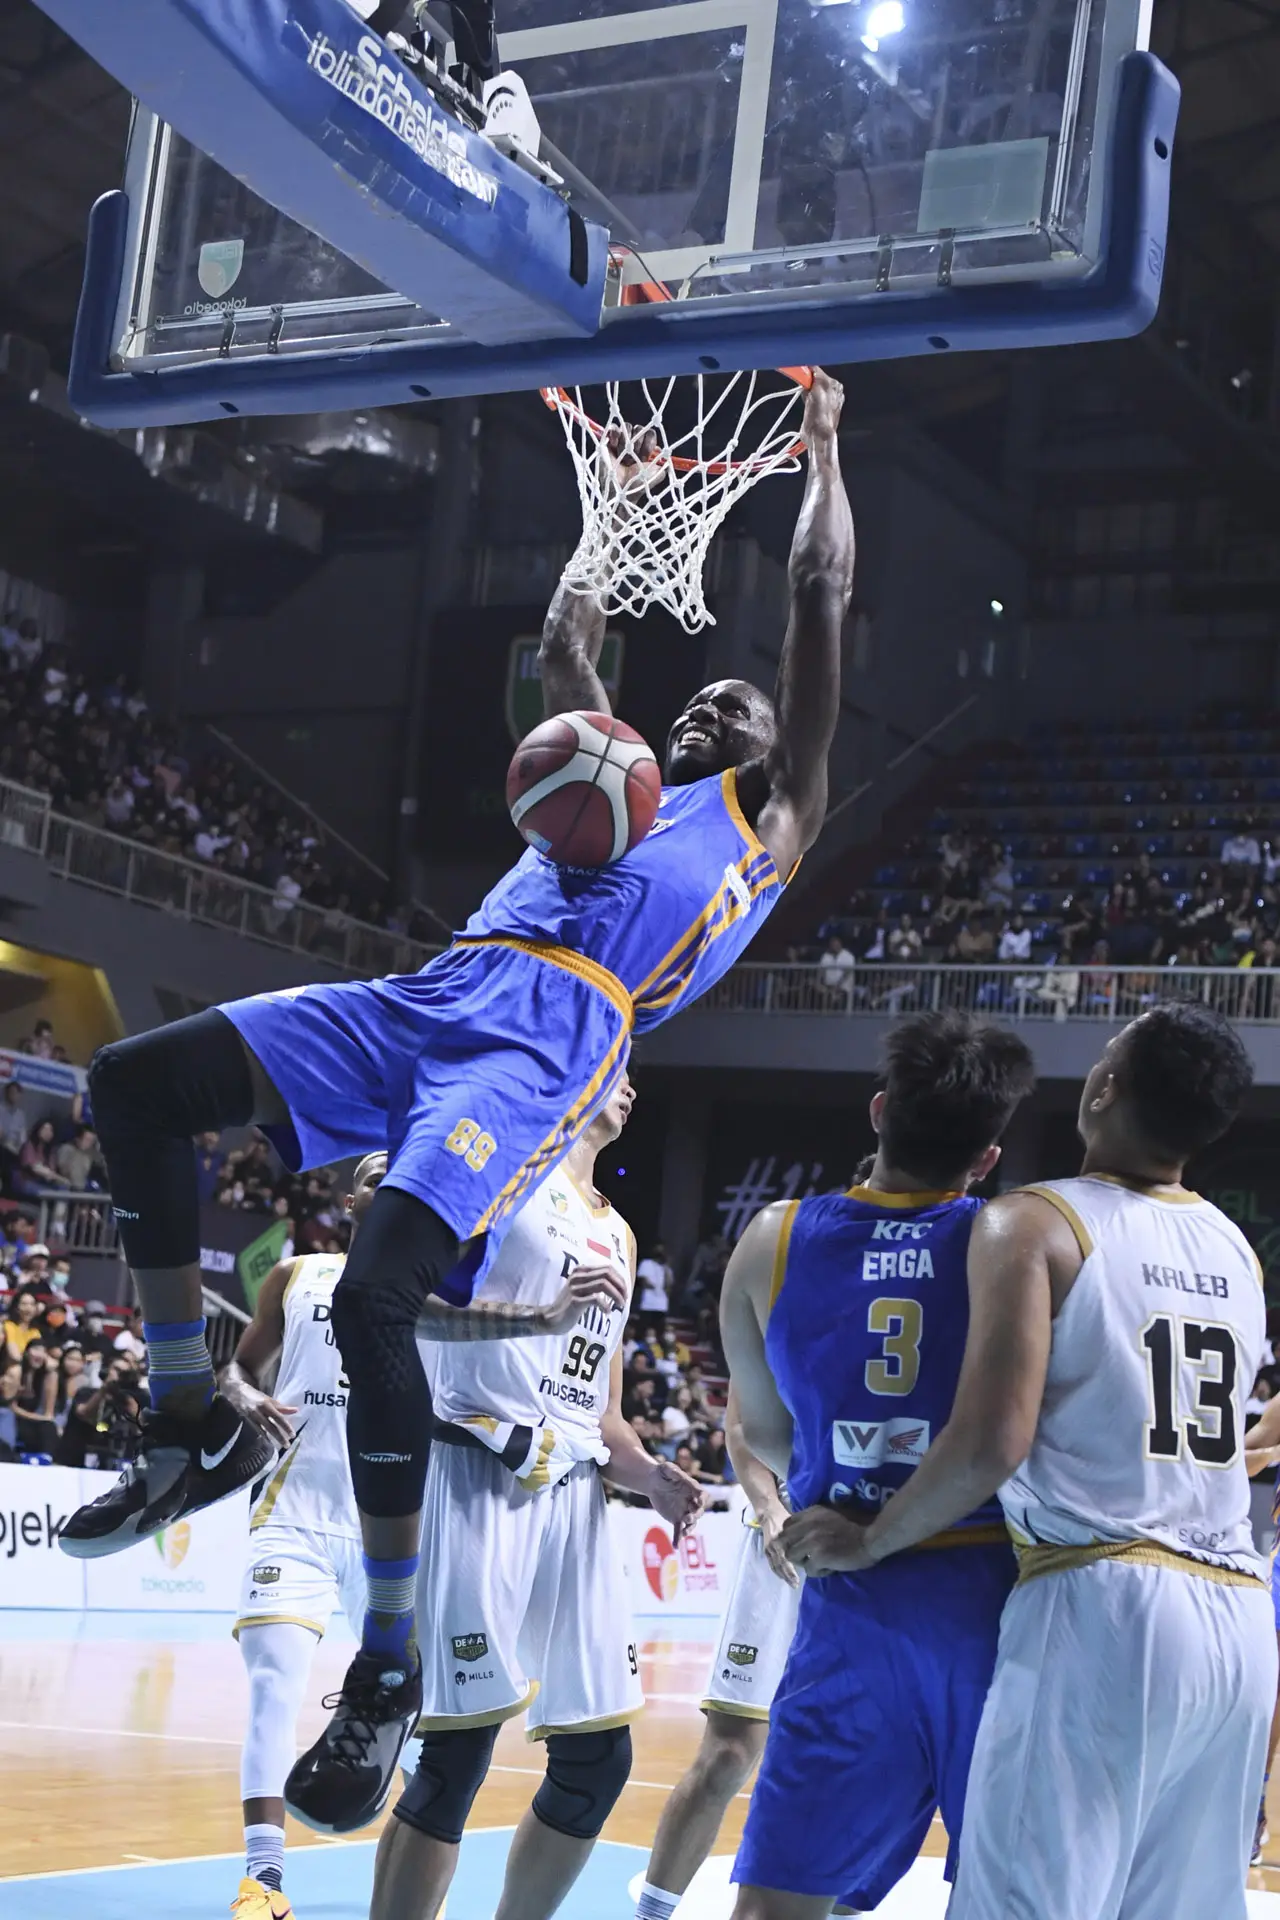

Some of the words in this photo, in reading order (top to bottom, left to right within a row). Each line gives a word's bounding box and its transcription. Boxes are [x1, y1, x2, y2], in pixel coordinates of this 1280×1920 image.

[445, 1117, 497, 1172] 89
[871, 1219, 933, 1240] KFC
[862, 1248, 935, 1281] ERGA
[1142, 1263, 1229, 1299] KALEB
[561, 1335, 607, 1382] 99
[865, 1298, 923, 1396] 3
[1139, 1312, 1238, 1469] 13
[0, 1503, 68, 1558] jek
[468, 1670, 495, 1681] MILLS
